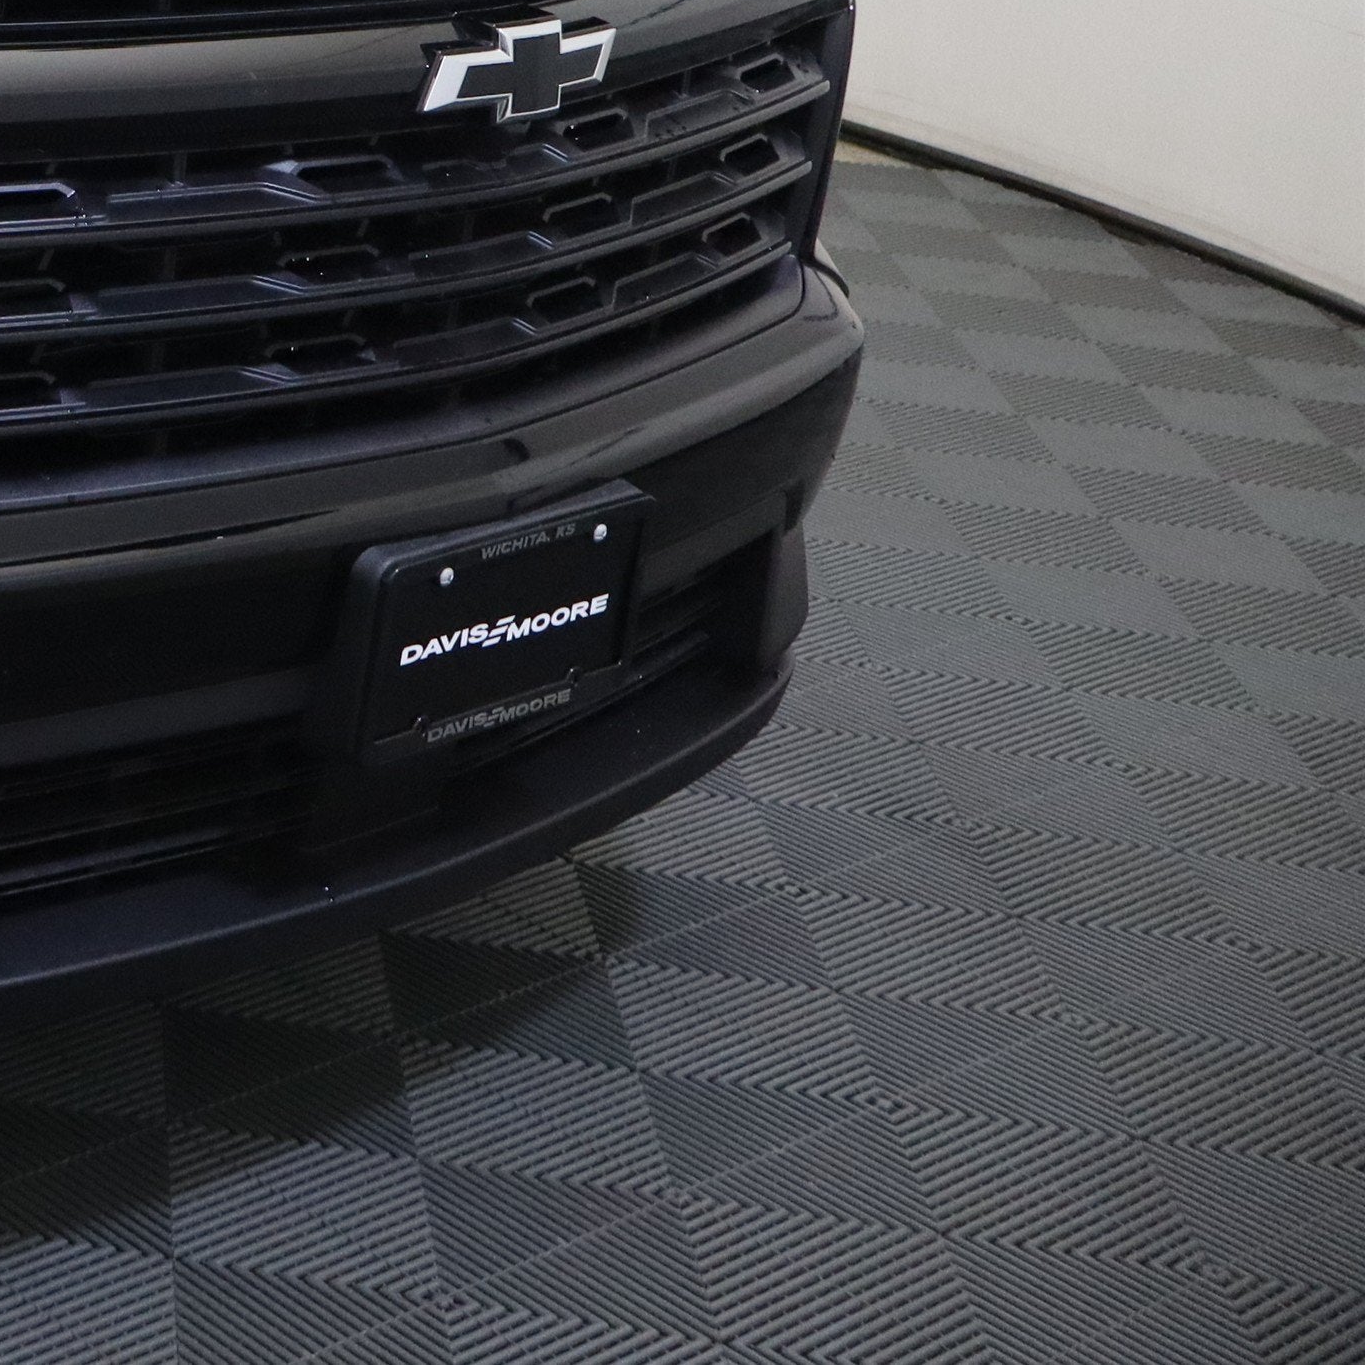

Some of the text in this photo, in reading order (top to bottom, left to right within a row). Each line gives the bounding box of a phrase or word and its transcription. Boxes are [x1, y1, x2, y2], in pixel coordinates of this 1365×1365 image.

[555, 522, 577, 539] KS
[399, 592, 610, 667] DAVIS MOORE
[426, 688, 572, 743] DAVIS MOORE
